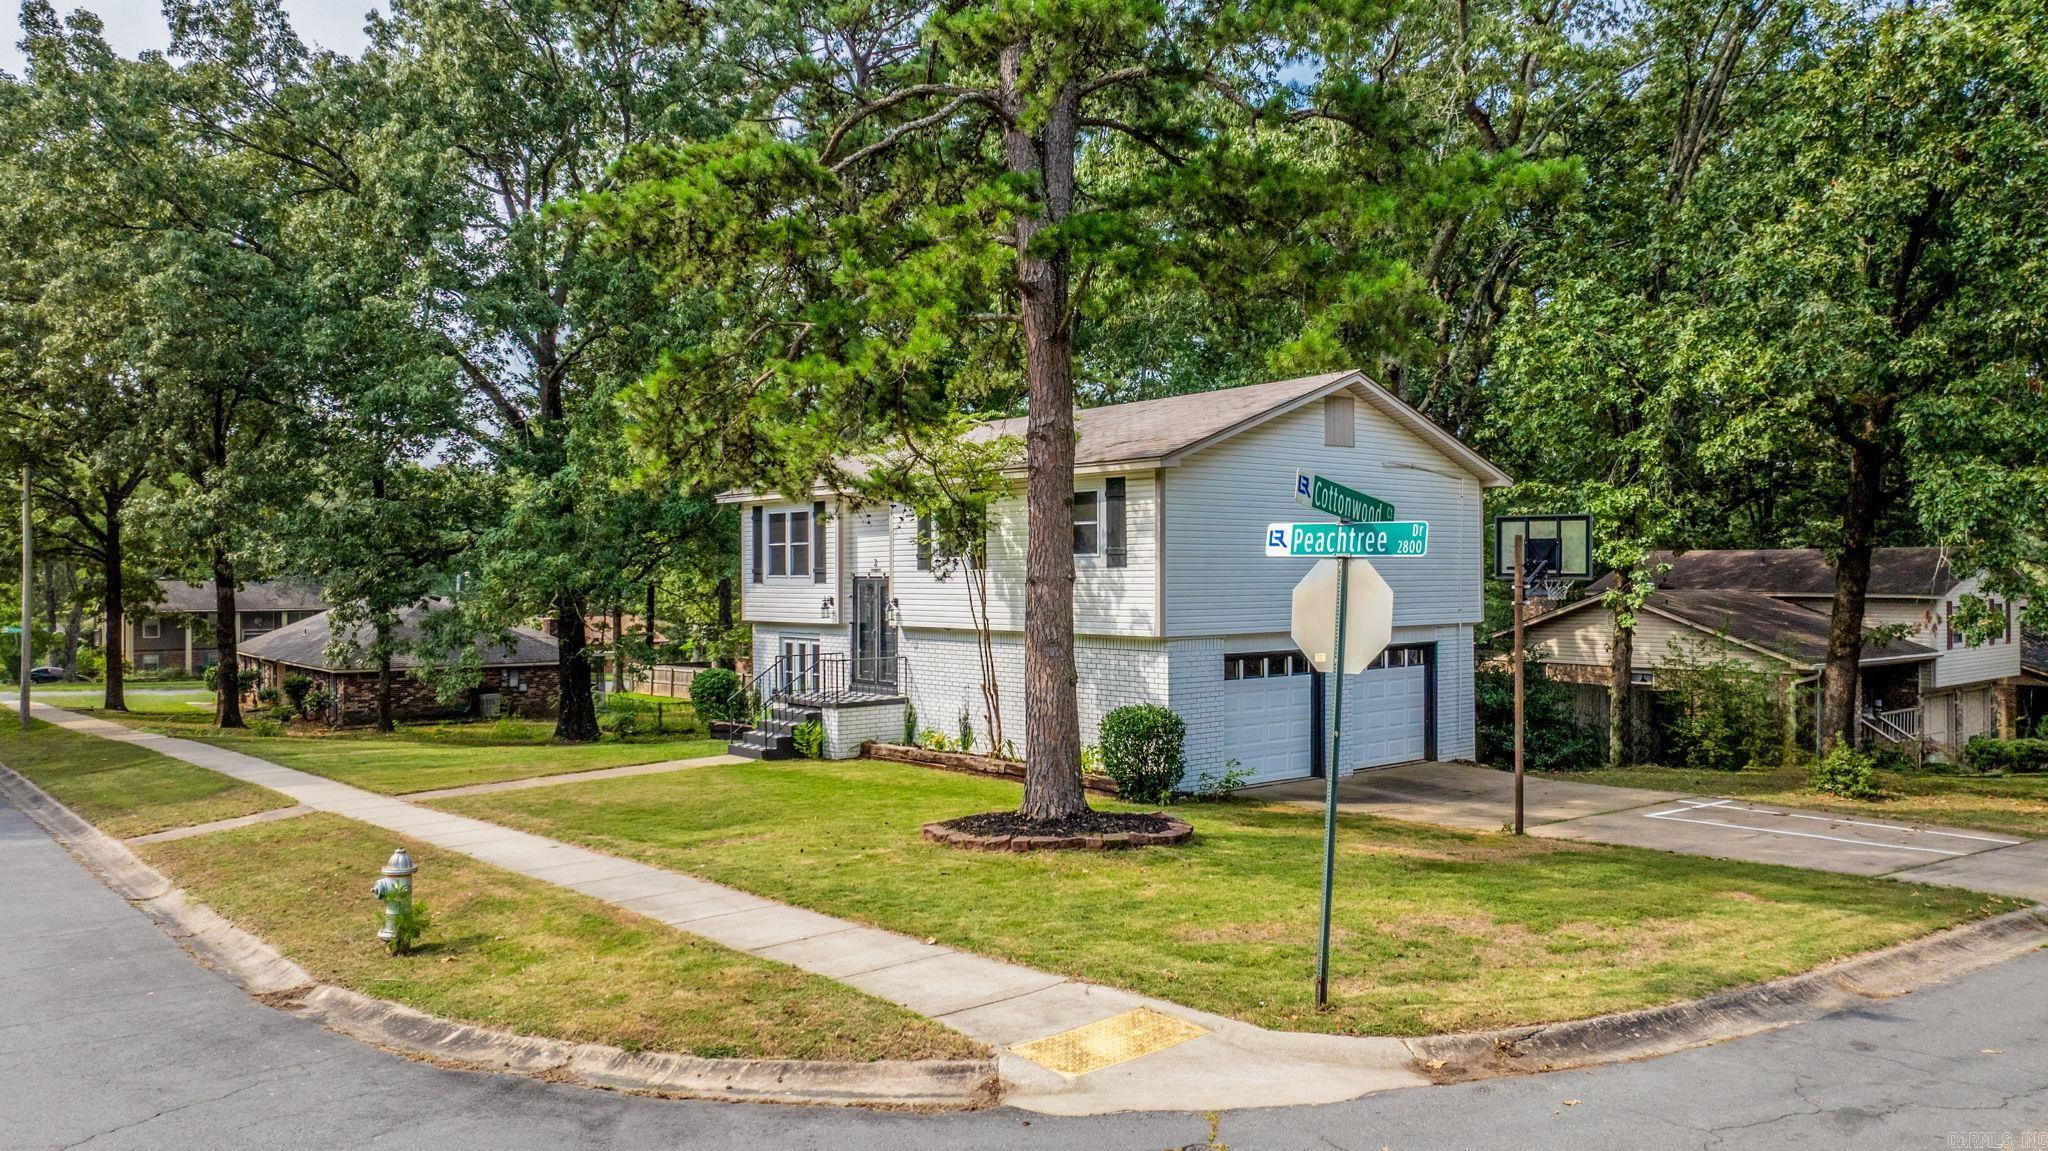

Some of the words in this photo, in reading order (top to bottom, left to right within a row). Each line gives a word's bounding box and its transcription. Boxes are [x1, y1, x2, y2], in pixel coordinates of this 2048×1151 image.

[1314, 481, 1383, 522] Cottonwood
[1386, 506, 1394, 521] Ct
[1293, 528, 1388, 553] Peachtree
[1412, 523, 1425, 537] Dr
[1397, 540, 1422, 554] 2800
